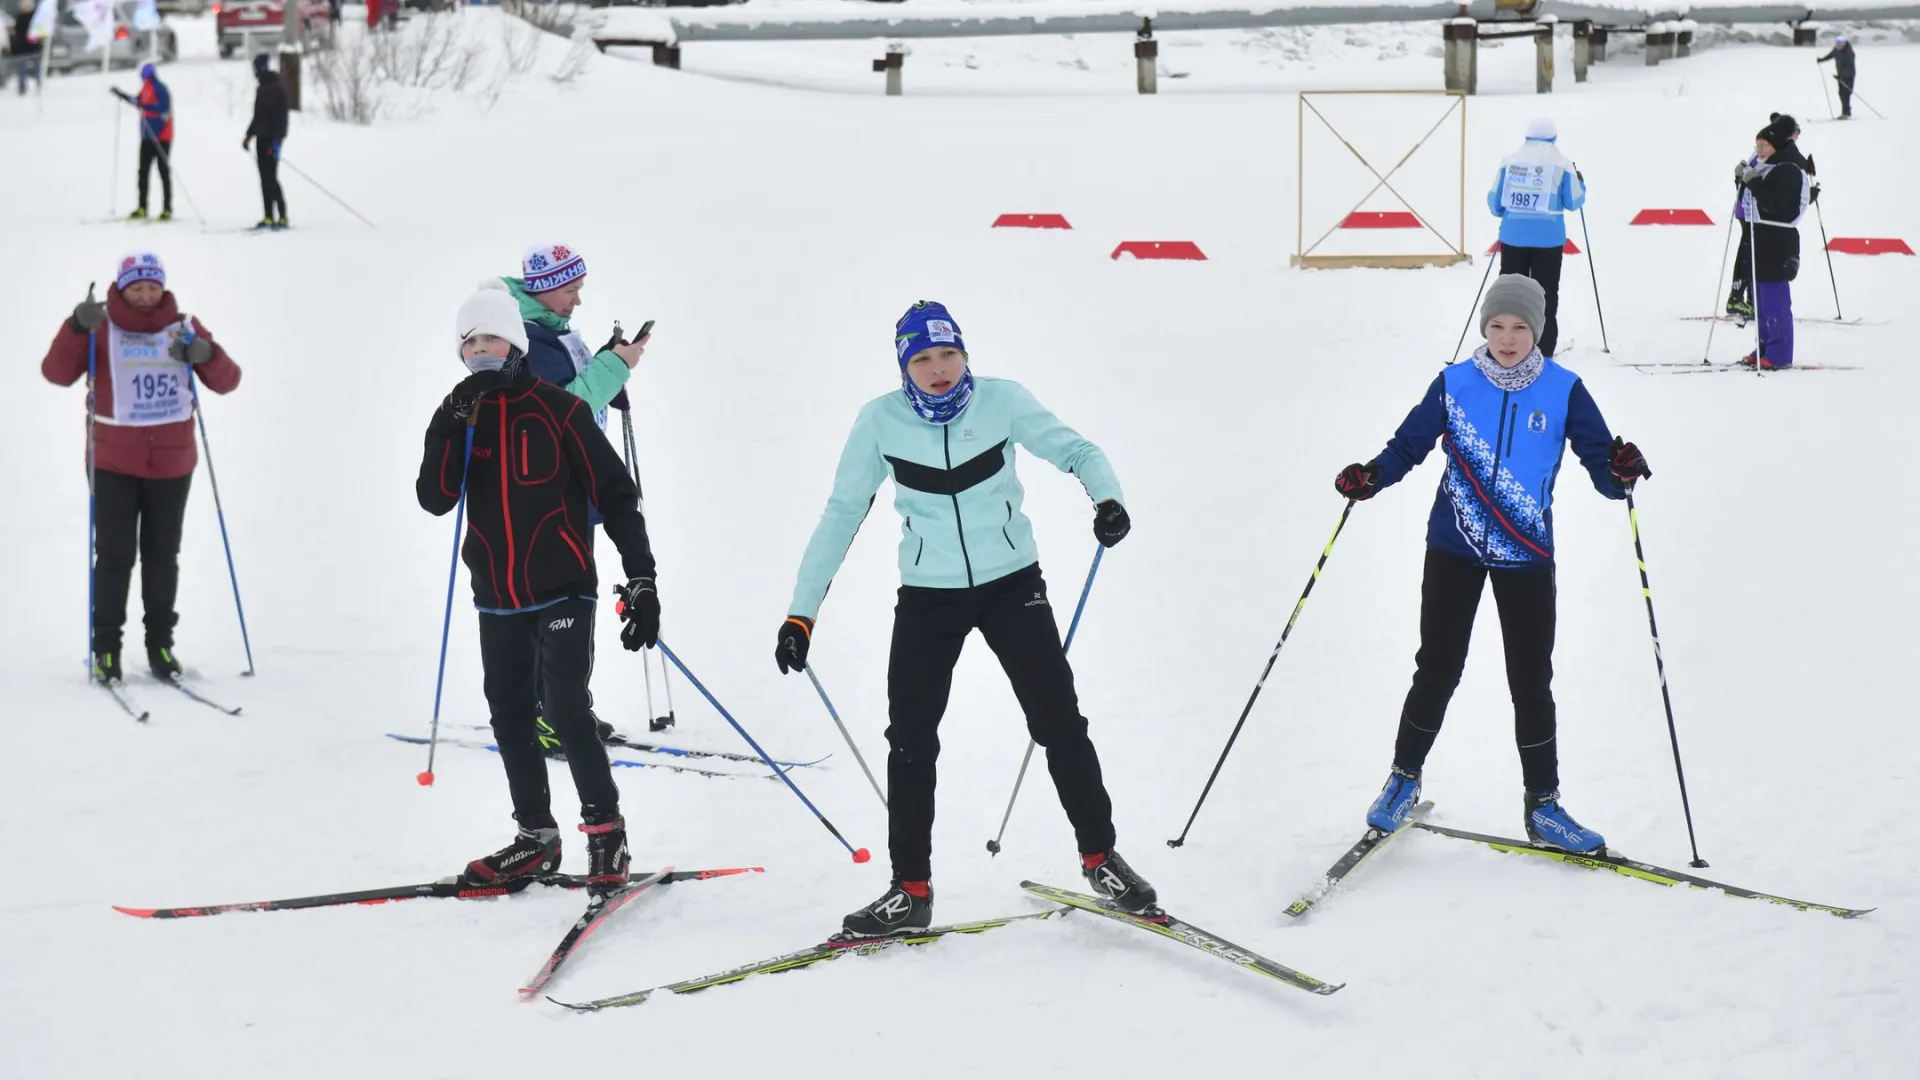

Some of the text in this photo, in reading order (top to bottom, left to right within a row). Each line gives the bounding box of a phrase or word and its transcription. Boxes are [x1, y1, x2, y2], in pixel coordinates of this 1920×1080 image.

[1511, 192, 1539, 208] 1987
[132, 374, 179, 400] 1952
[1531, 811, 1583, 845] SPINE
[1563, 855, 1619, 872] FISCHER
[458, 887, 509, 897] ROSSIGNOL
[1173, 929, 1255, 967] FISCHER
